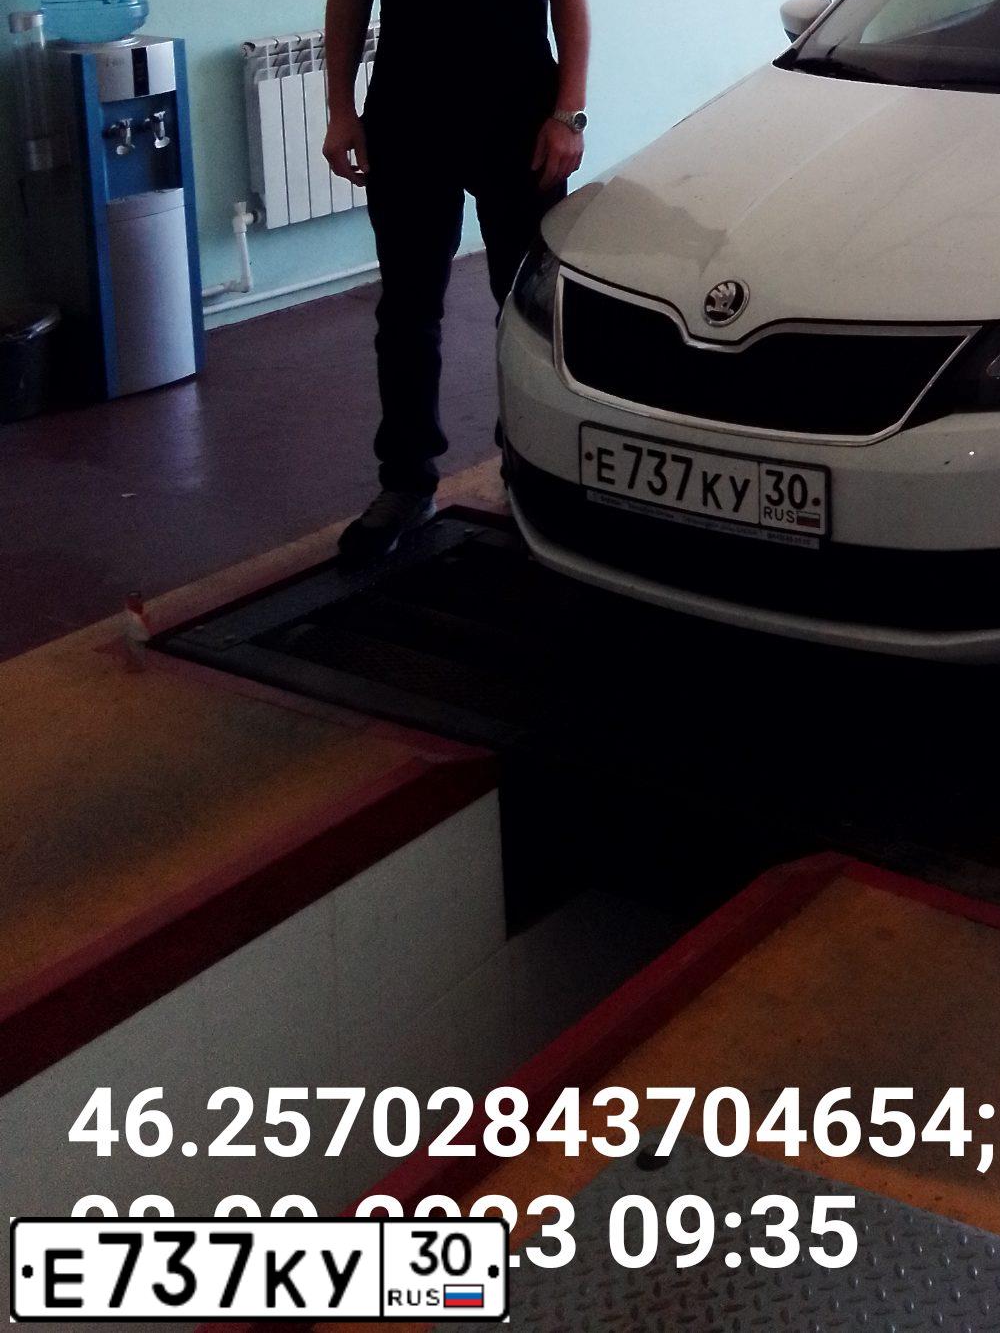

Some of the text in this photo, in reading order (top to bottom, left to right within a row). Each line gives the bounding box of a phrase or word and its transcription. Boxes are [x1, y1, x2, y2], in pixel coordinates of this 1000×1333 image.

[597, 443, 751, 513] Е737КУ
[765, 469, 808, 510] 30
[763, 505, 796, 524] RUS
